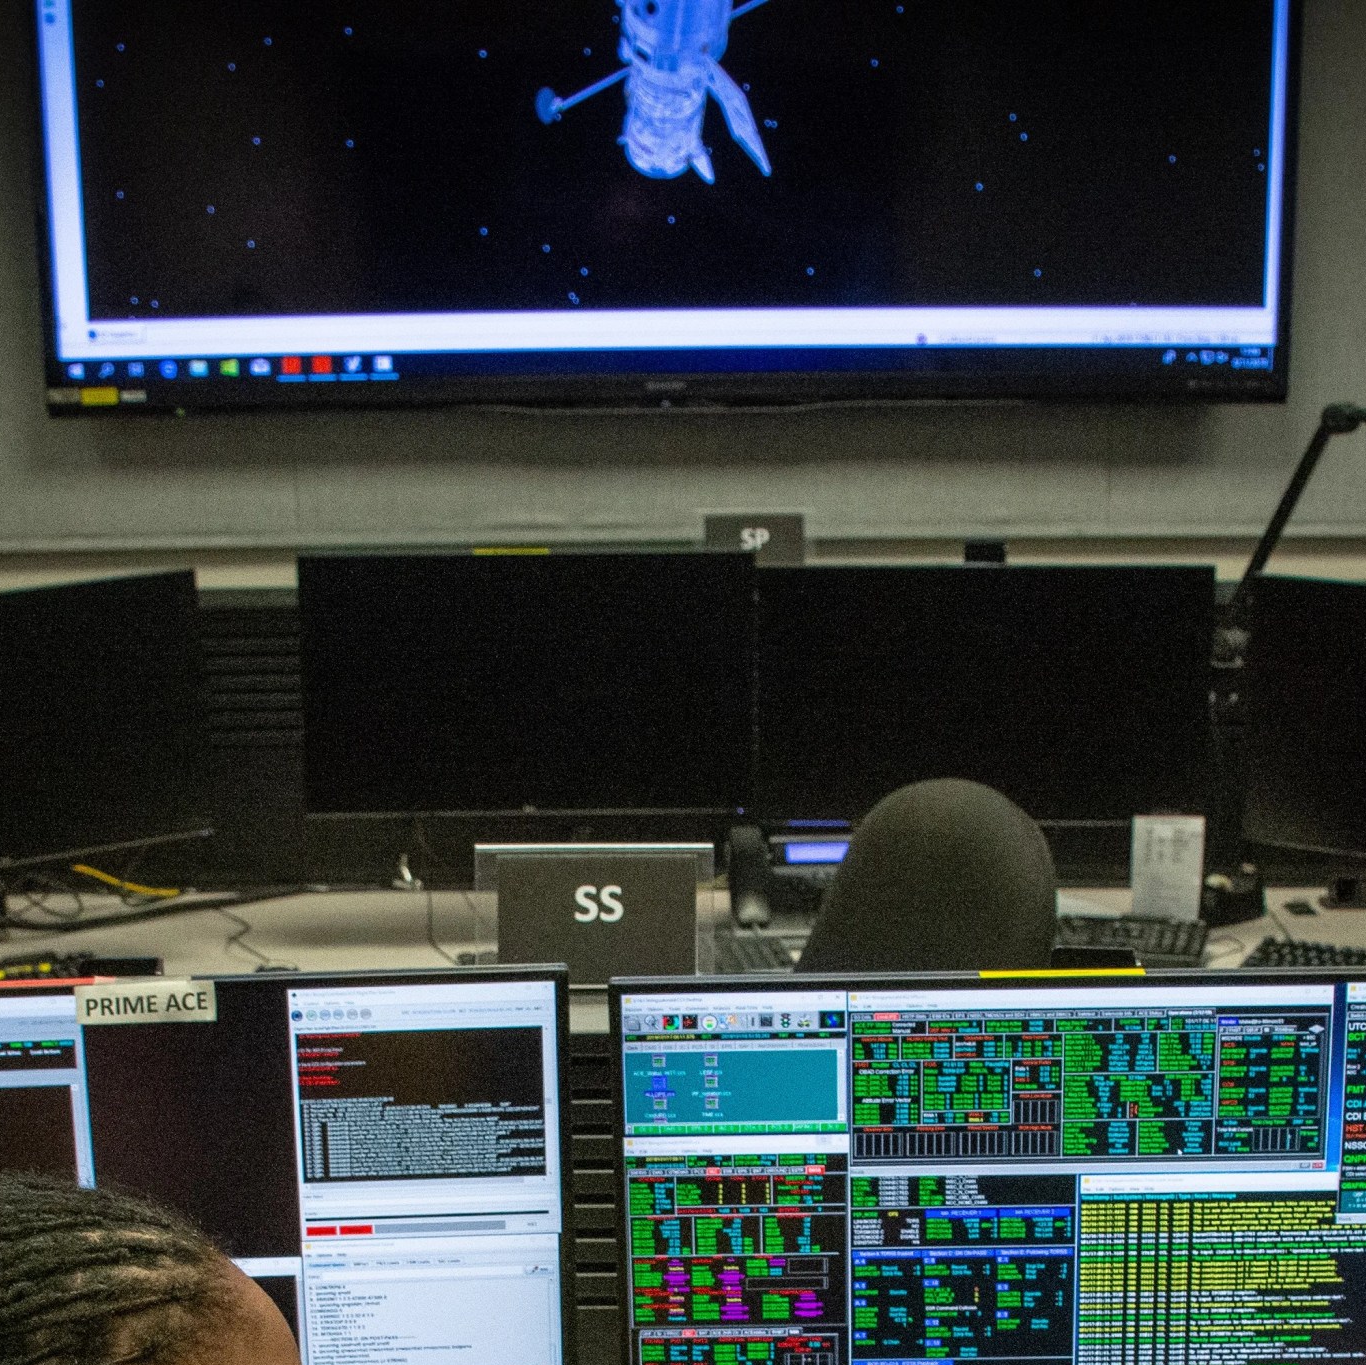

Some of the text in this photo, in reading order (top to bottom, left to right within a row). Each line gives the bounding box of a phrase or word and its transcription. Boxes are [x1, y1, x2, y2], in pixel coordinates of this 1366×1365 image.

[740, 527, 769, 550] SP
[575, 885, 624, 923] SS
[85, 991, 209, 1017] PRIME ACE
[1347, 1085, 1365, 1094] FMT
